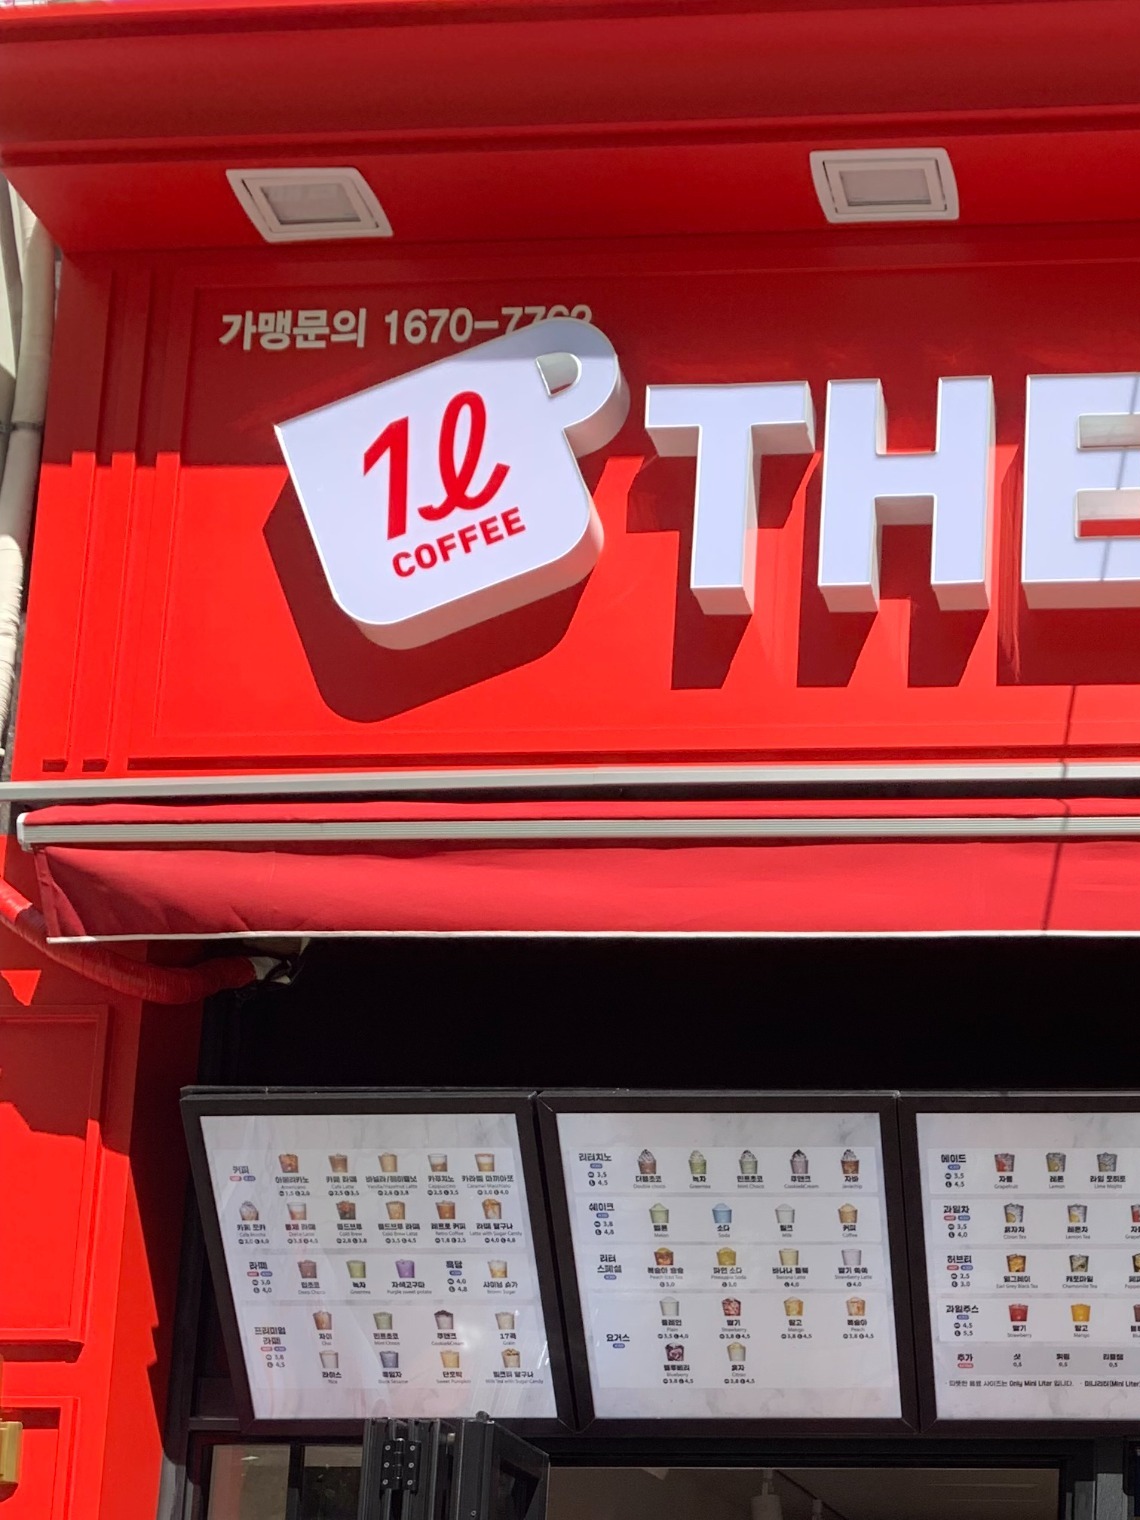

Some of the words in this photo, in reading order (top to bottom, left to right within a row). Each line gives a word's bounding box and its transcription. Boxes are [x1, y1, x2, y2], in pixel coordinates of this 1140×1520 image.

[218, 307, 367, 351] 가맹문의
[391, 506, 527, 578] COFFEE
[579, 1153, 612, 1161] 리터치노
[941, 1154, 966, 1163] 에이드
[944, 1205, 970, 1214] 과일차
[600, 1254, 616, 1262] 리터
[947, 1255, 972, 1263] 허브티
[946, 1305, 979, 1313] 과일주스
[957, 1353, 973, 1362] 추가
